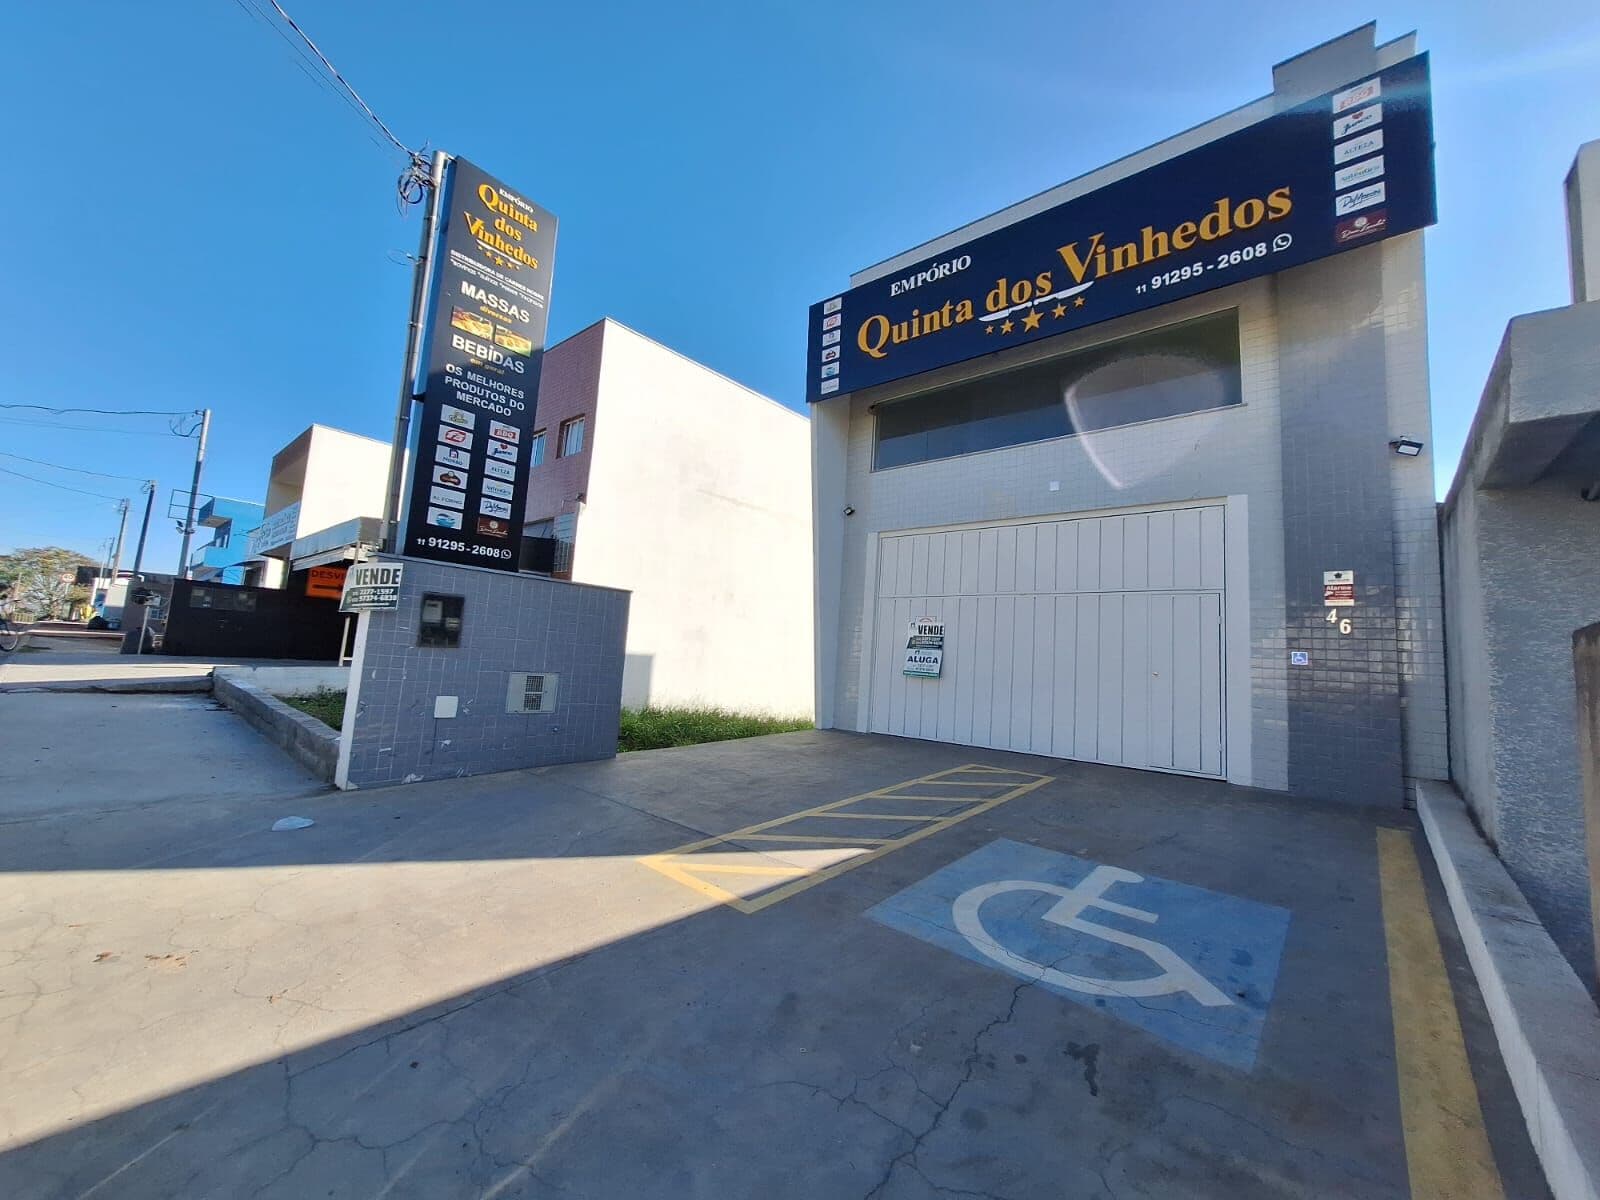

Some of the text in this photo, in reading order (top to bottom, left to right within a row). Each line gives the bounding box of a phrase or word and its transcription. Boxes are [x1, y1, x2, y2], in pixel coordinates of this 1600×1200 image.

[478, 183, 538, 232] Quinta
[463, 210, 539, 270] Vinhedos
[494, 217, 522, 241] dos
[857, 185, 1293, 359] Quinta dos Vinhedos
[890, 255, 972, 297] EMPÓRIO
[461, 280, 531, 324] MASSAS
[1136, 284, 1147, 295] 11
[444, 375, 526, 412] PRODUTOS DO
[445, 363, 525, 400] OS MELHORES
[455, 389, 513, 418] MERCADO
[311, 569, 347, 579] DESVI
[356, 567, 401, 586] VENDE
[918, 624, 945, 635] VENDE
[907, 655, 939, 664] ALUGA
